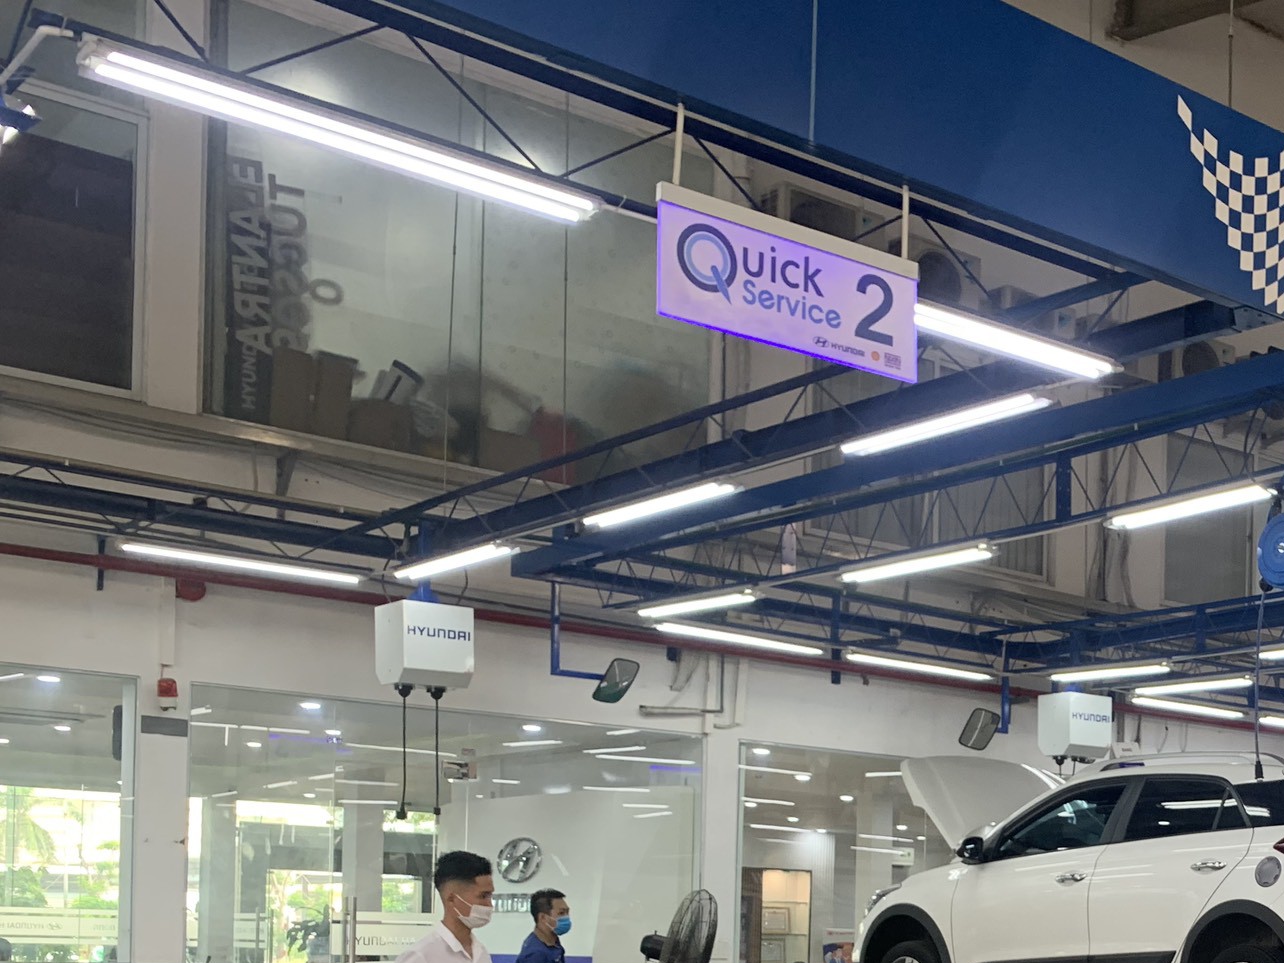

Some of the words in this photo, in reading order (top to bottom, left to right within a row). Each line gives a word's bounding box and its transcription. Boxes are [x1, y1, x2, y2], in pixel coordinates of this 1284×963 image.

[677, 223, 824, 304] Quick
[742, 279, 842, 329] Service
[854, 273, 894, 347] 2
[407, 625, 471, 642] HYUNDAI
[1072, 712, 1111, 723] HYUNDAI
